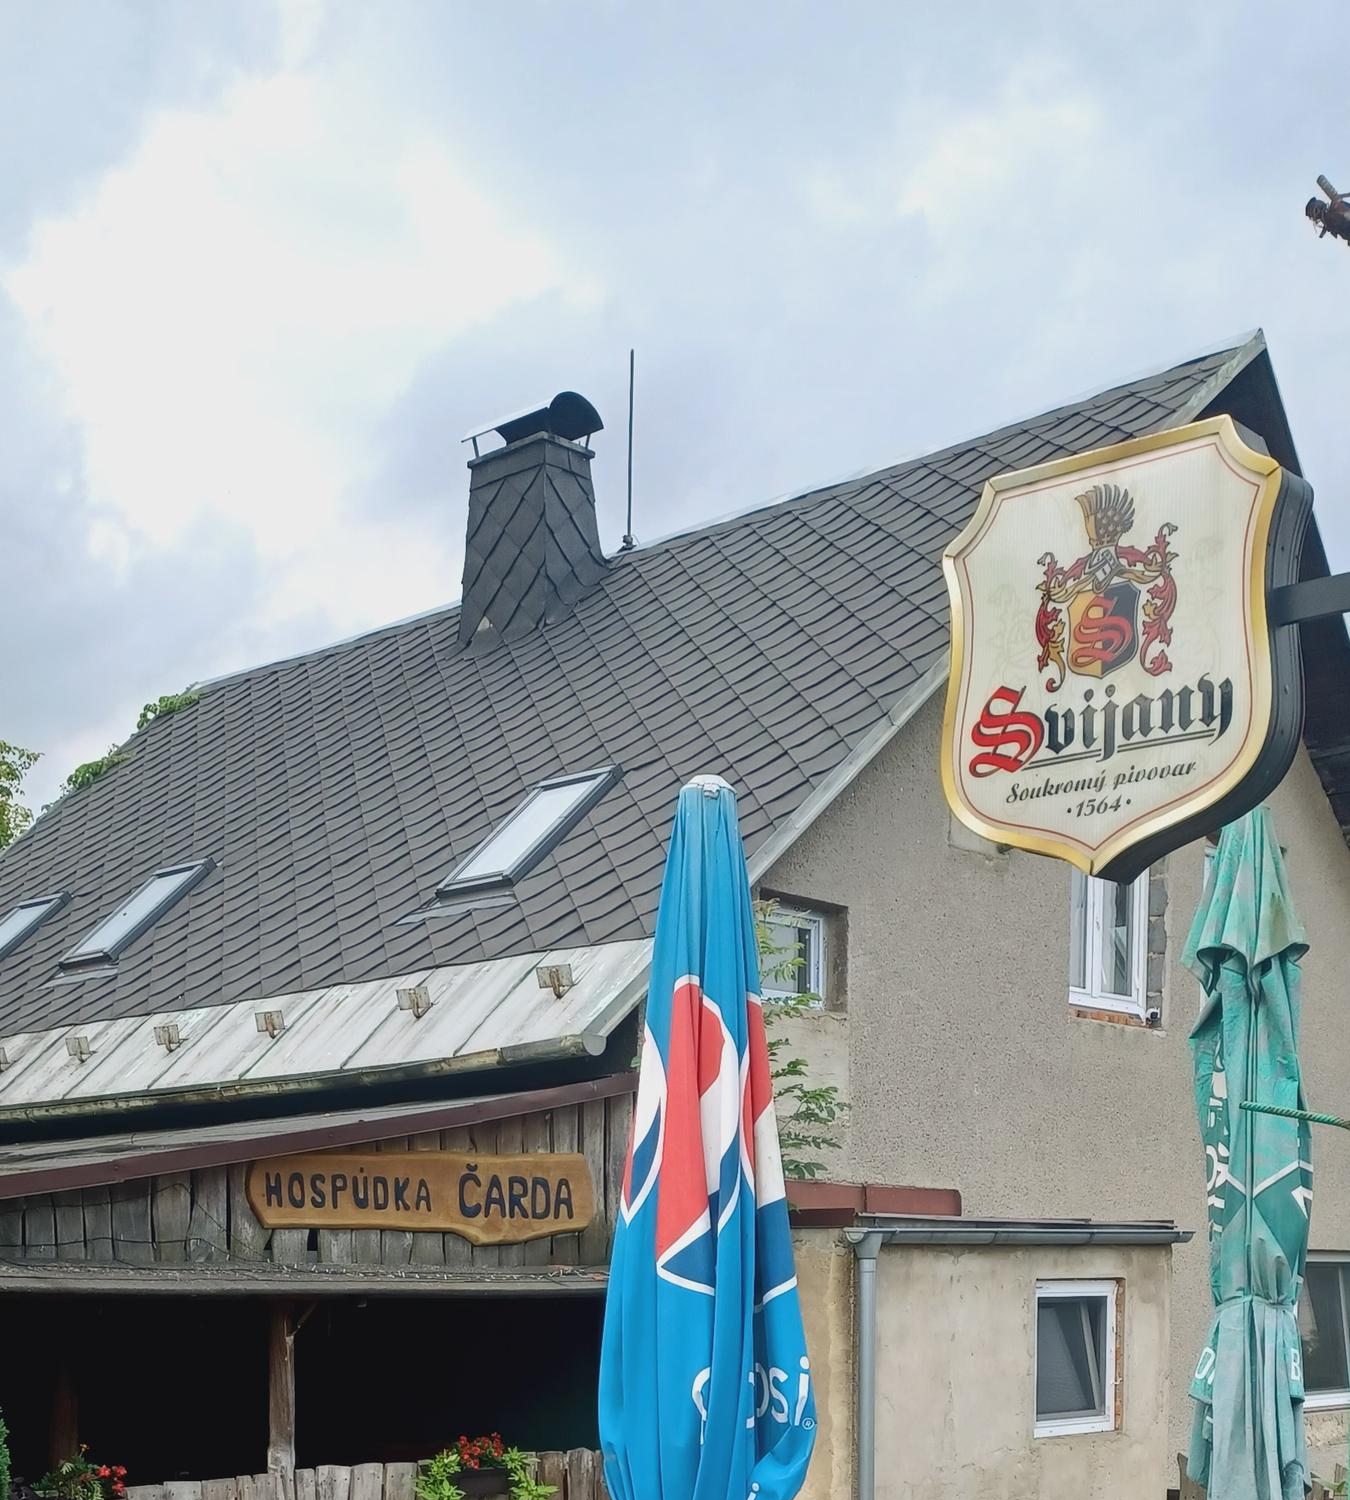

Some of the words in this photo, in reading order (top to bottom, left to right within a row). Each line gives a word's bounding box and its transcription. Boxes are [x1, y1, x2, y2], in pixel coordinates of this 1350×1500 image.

[969, 672, 1234, 778] Svijany
[1006, 770, 1106, 804] Soukromý
[1113, 761, 1197, 790] pivovar
[458, 1163, 574, 1220] ČARDA
